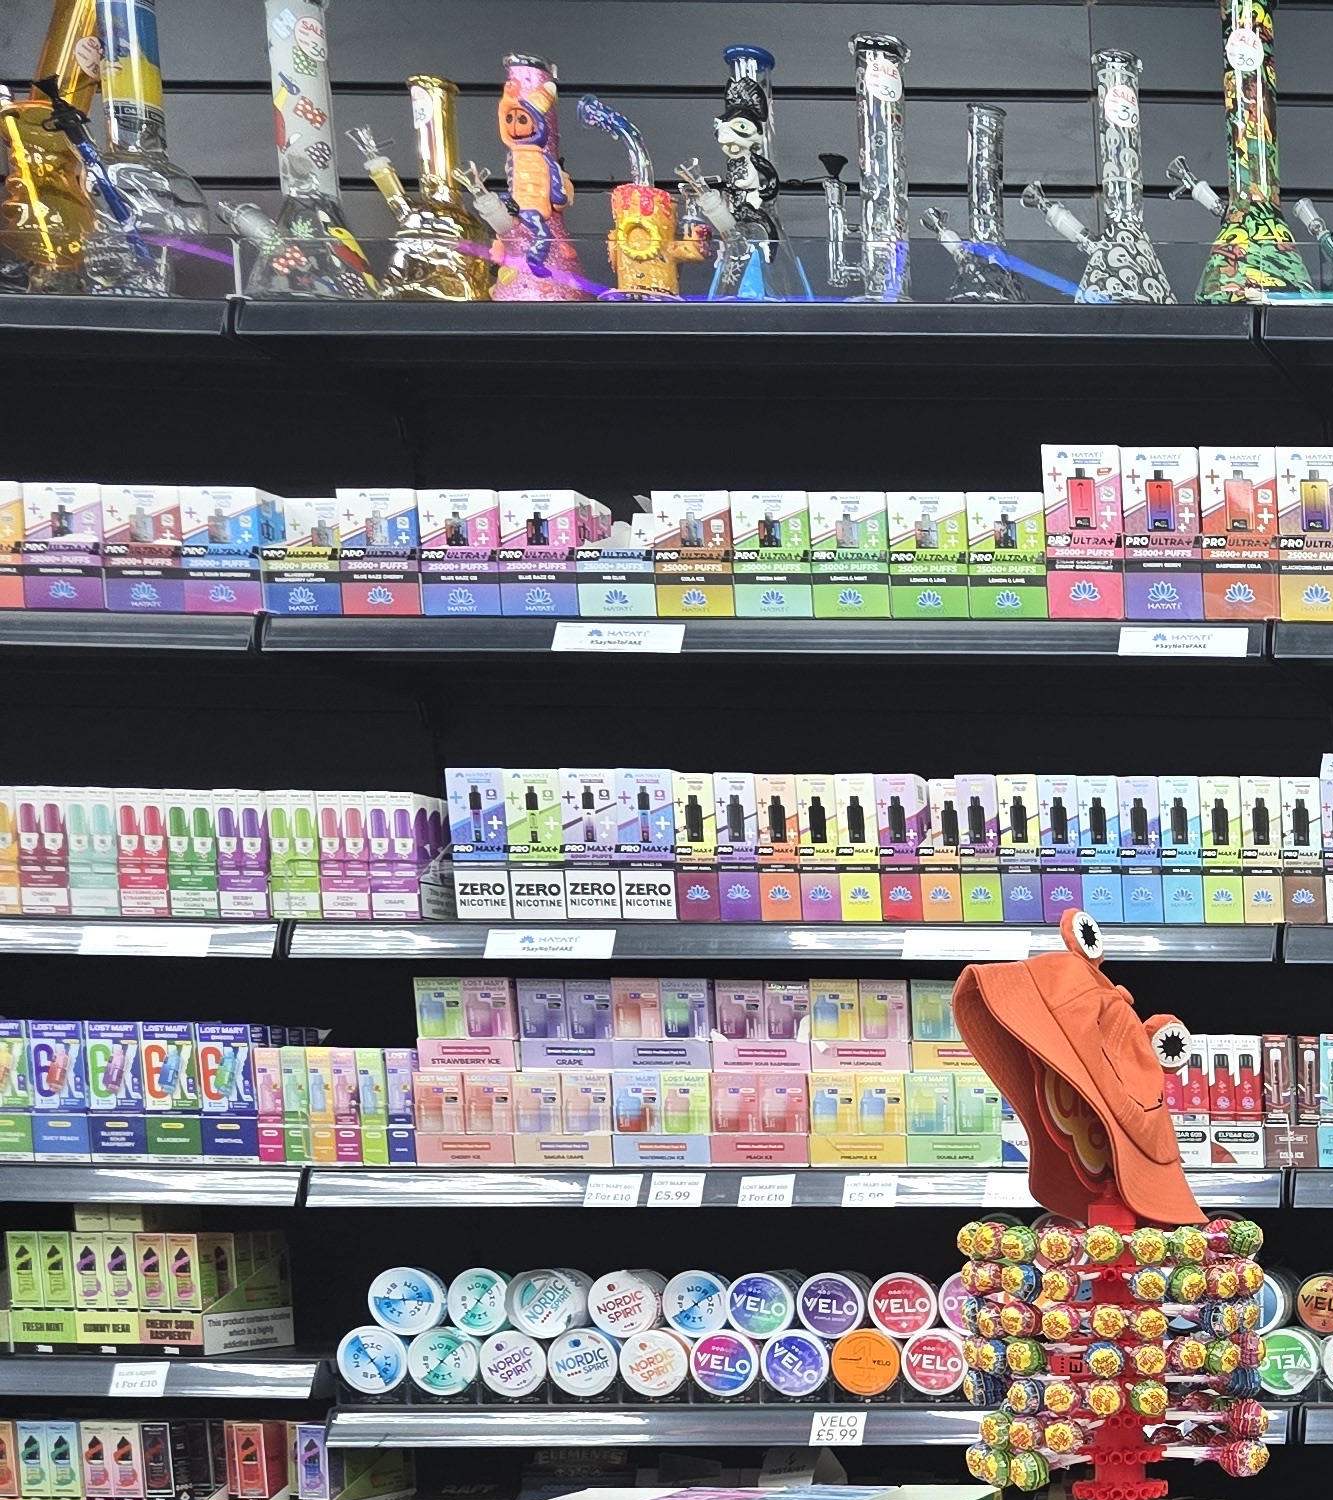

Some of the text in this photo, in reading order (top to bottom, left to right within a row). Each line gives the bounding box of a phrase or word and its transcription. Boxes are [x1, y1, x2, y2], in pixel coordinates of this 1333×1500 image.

[1127, 536, 1195, 547] PRO ULTRA+
[459, 883, 505, 896] ZERO
[460, 899, 507, 907] NICOTINE
[820, 1416, 857, 1428] VELO
[817, 1429, 857, 1442] £5.99
